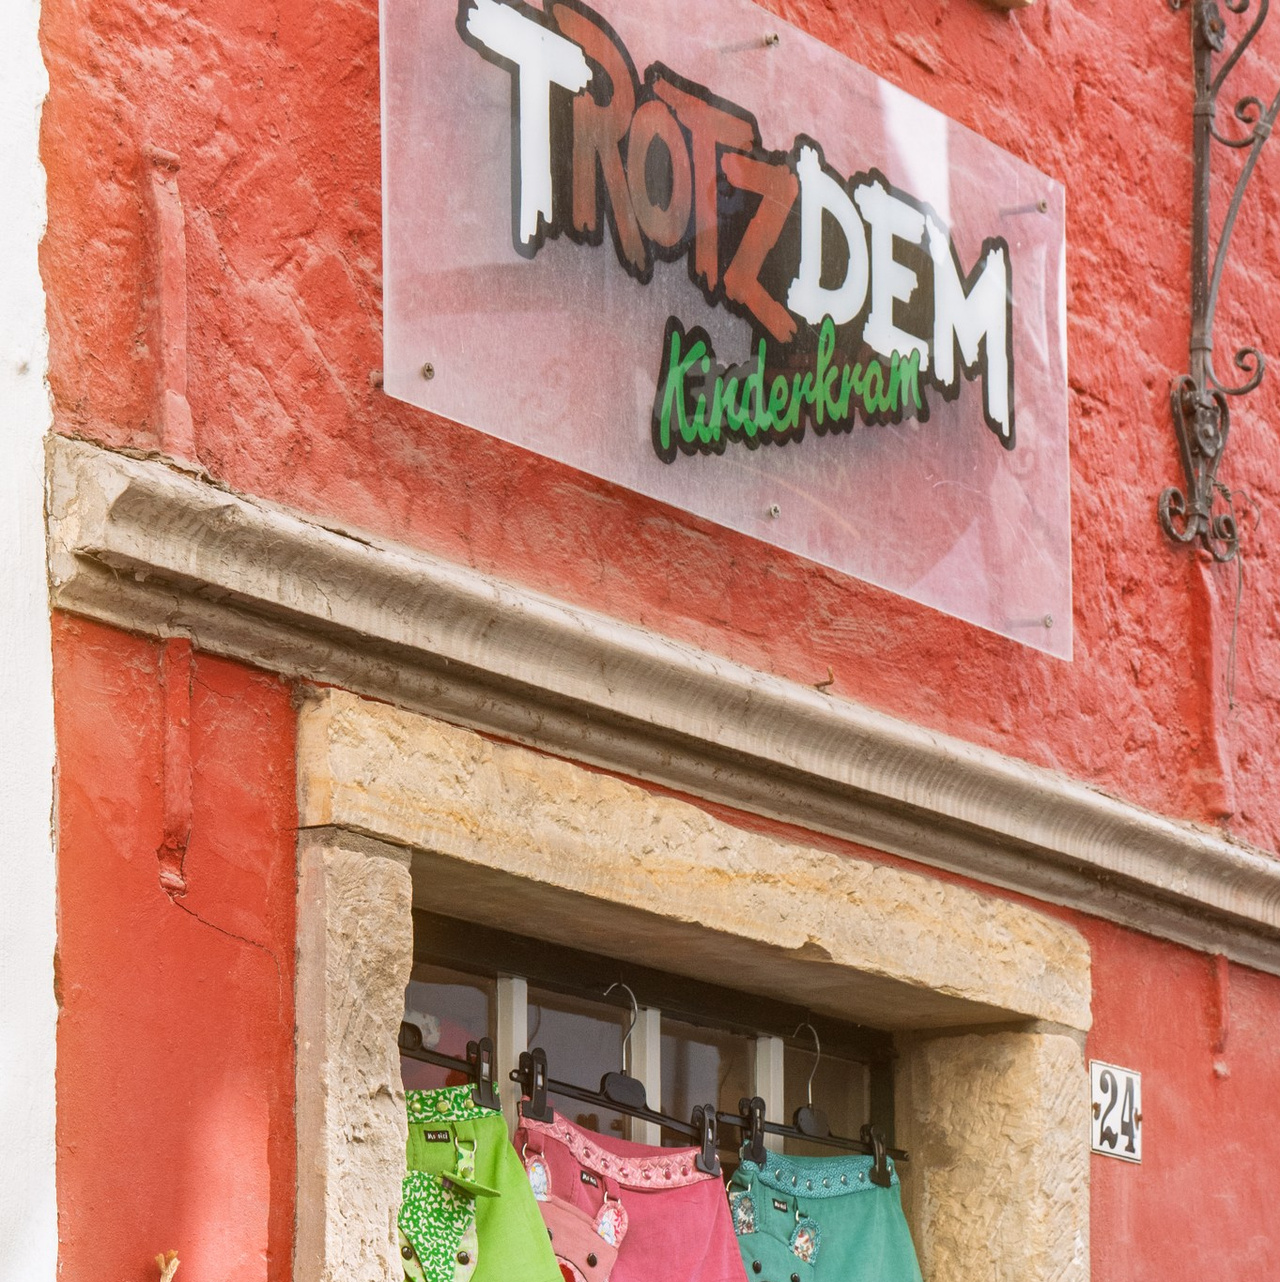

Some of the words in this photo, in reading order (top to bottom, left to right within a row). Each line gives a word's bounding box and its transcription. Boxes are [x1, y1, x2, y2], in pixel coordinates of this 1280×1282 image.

[462, 0, 1012, 445] TROTZDEM
[658, 314, 923, 450] Kinderkram
[1100, 1069, 1136, 1154] 24
